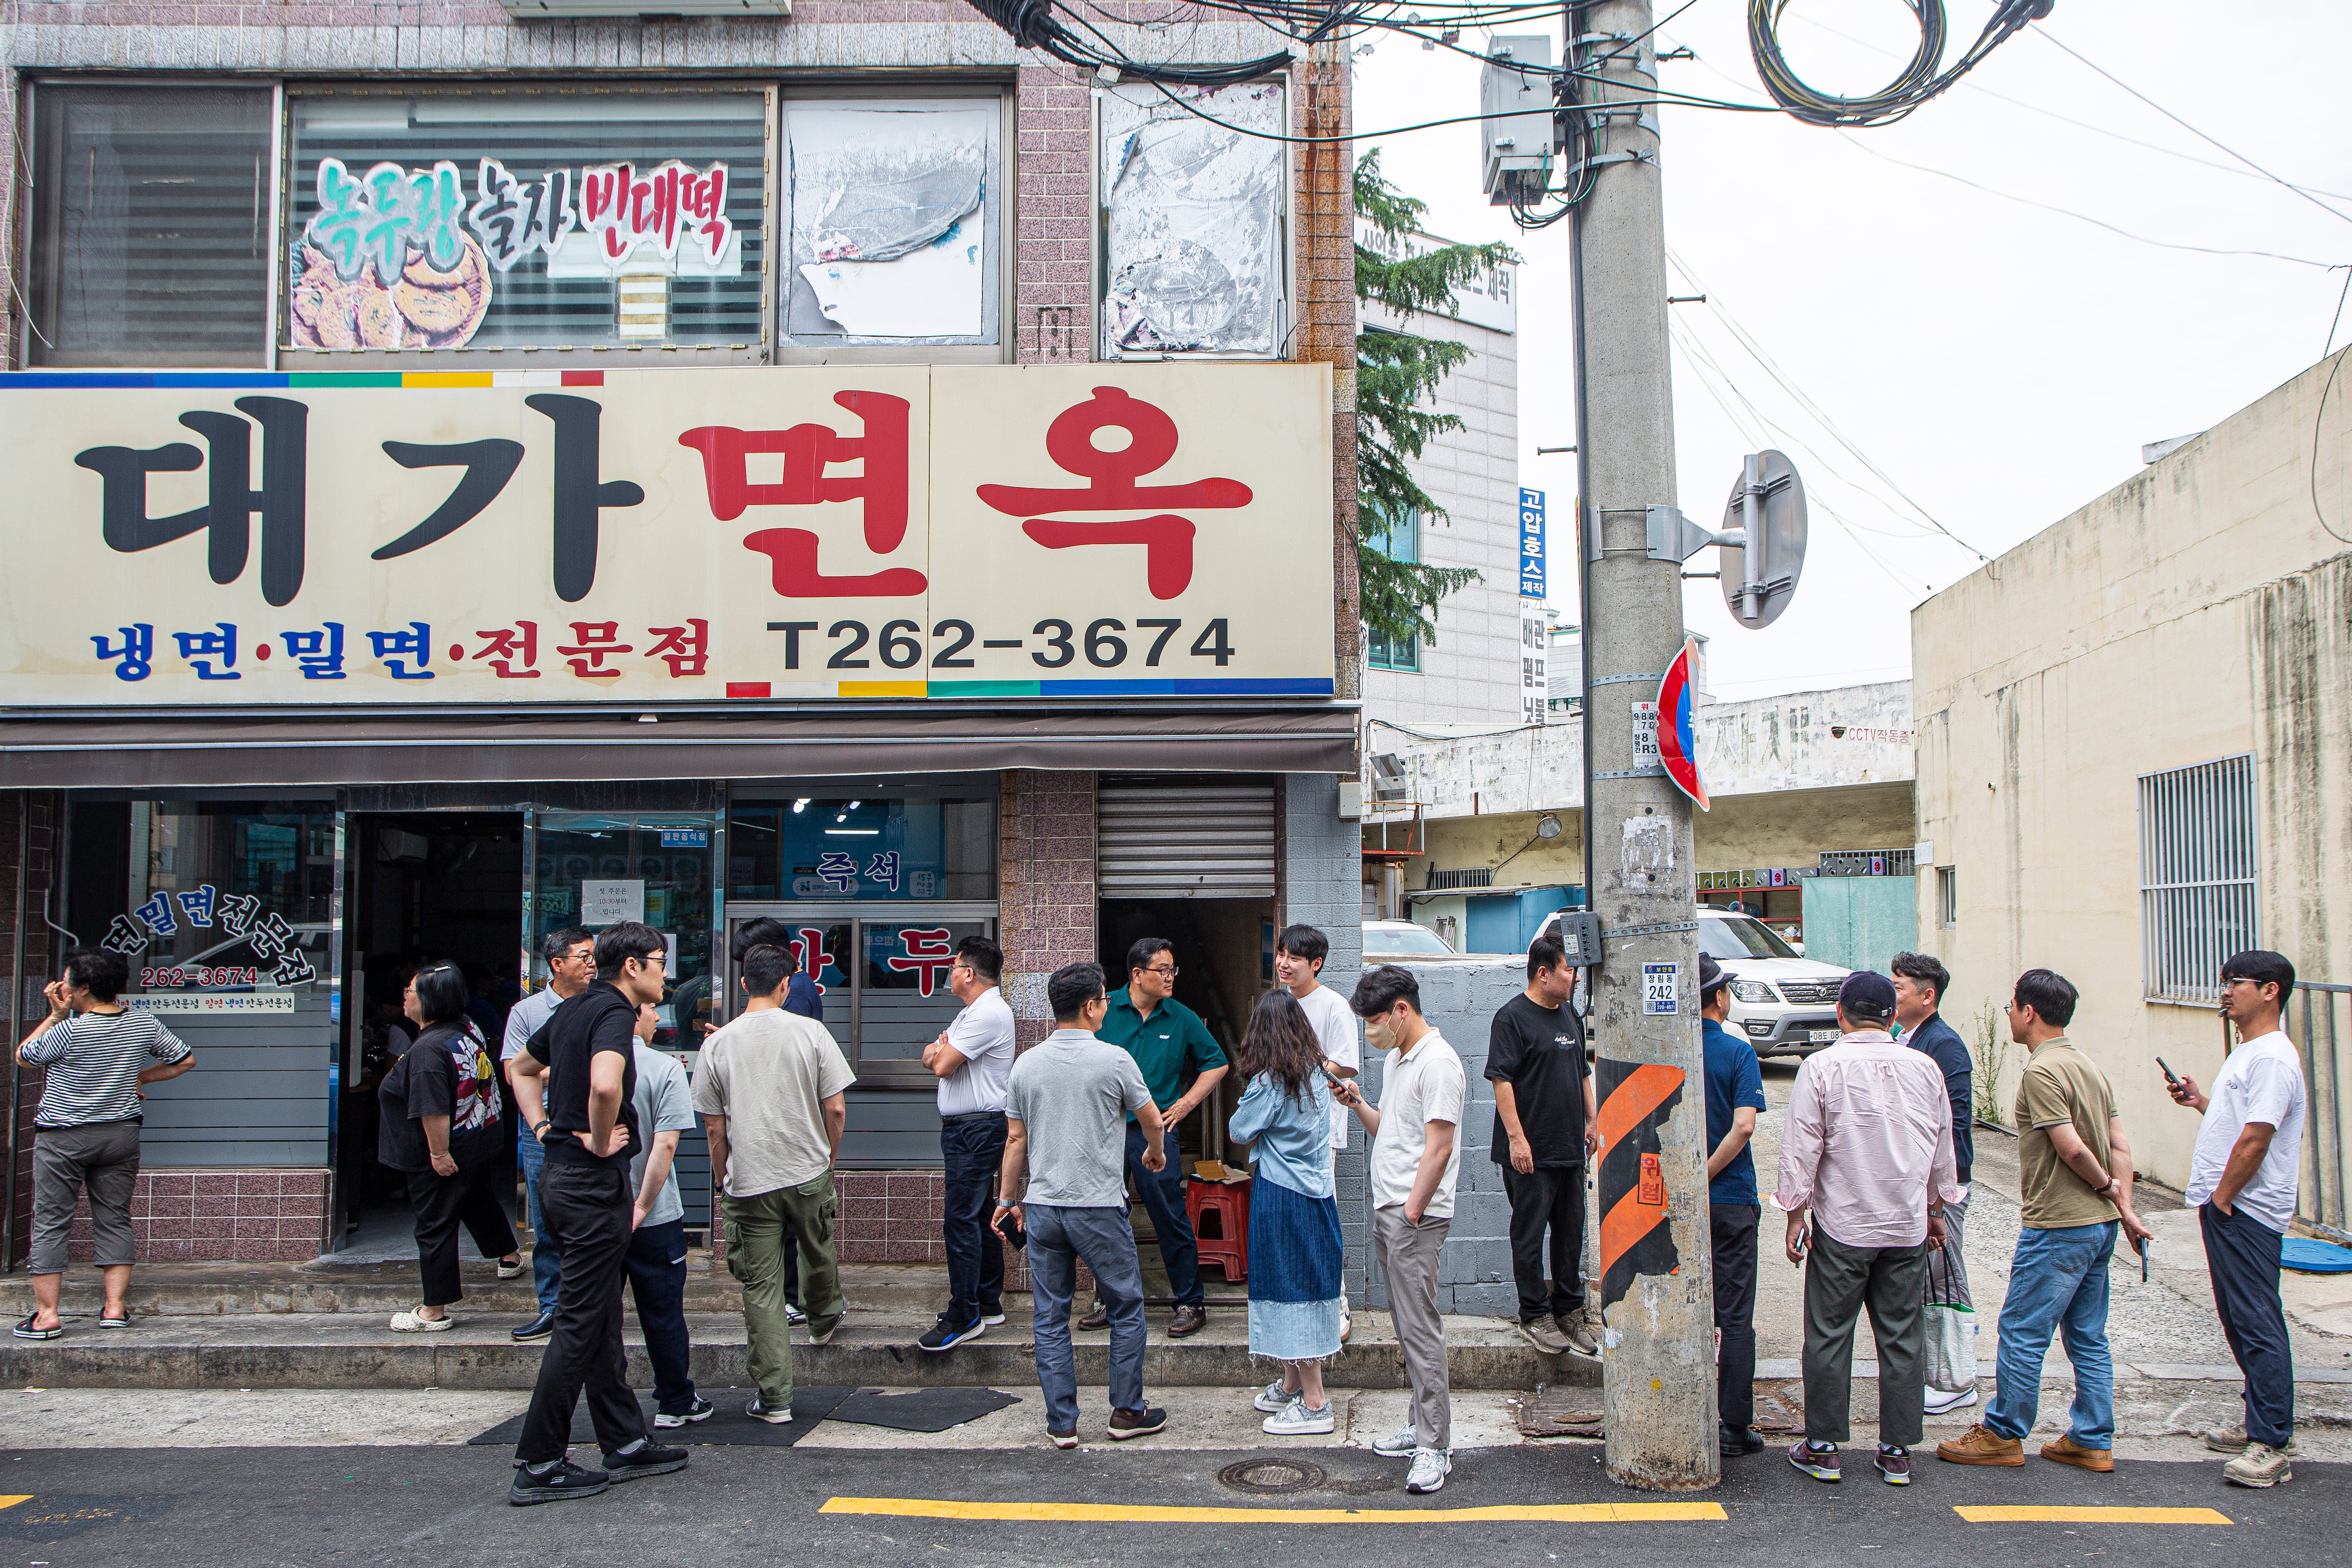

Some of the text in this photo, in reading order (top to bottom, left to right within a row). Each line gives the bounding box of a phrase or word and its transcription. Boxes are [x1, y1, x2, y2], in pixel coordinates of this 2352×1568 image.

[480, 167, 567, 260] 놀자
[587, 166, 723, 258] 빈대떡
[74, 386, 1253, 607] 대가면옥
[1521, 489, 1543, 580] 고압호스
[1521, 581, 1544, 595] 제작
[1523, 618, 1545, 650] 배관
[1523, 657, 1545, 688] 펌프
[1642, 733, 1648, 742] 8
[1848, 727, 1909, 744] CCTV작동중
[1642, 744, 1657, 753] R3
[816, 851, 899, 892] 즉석
[141, 966, 258, 987] 262-3674
[1648, 974, 1673, 983] 장림동
[1649, 985, 1672, 999] 242
[205, 998, 223, 1009] 밀면
[225, 998, 243, 1008] 냉면
[1642, 1157, 1660, 1201] 위험
